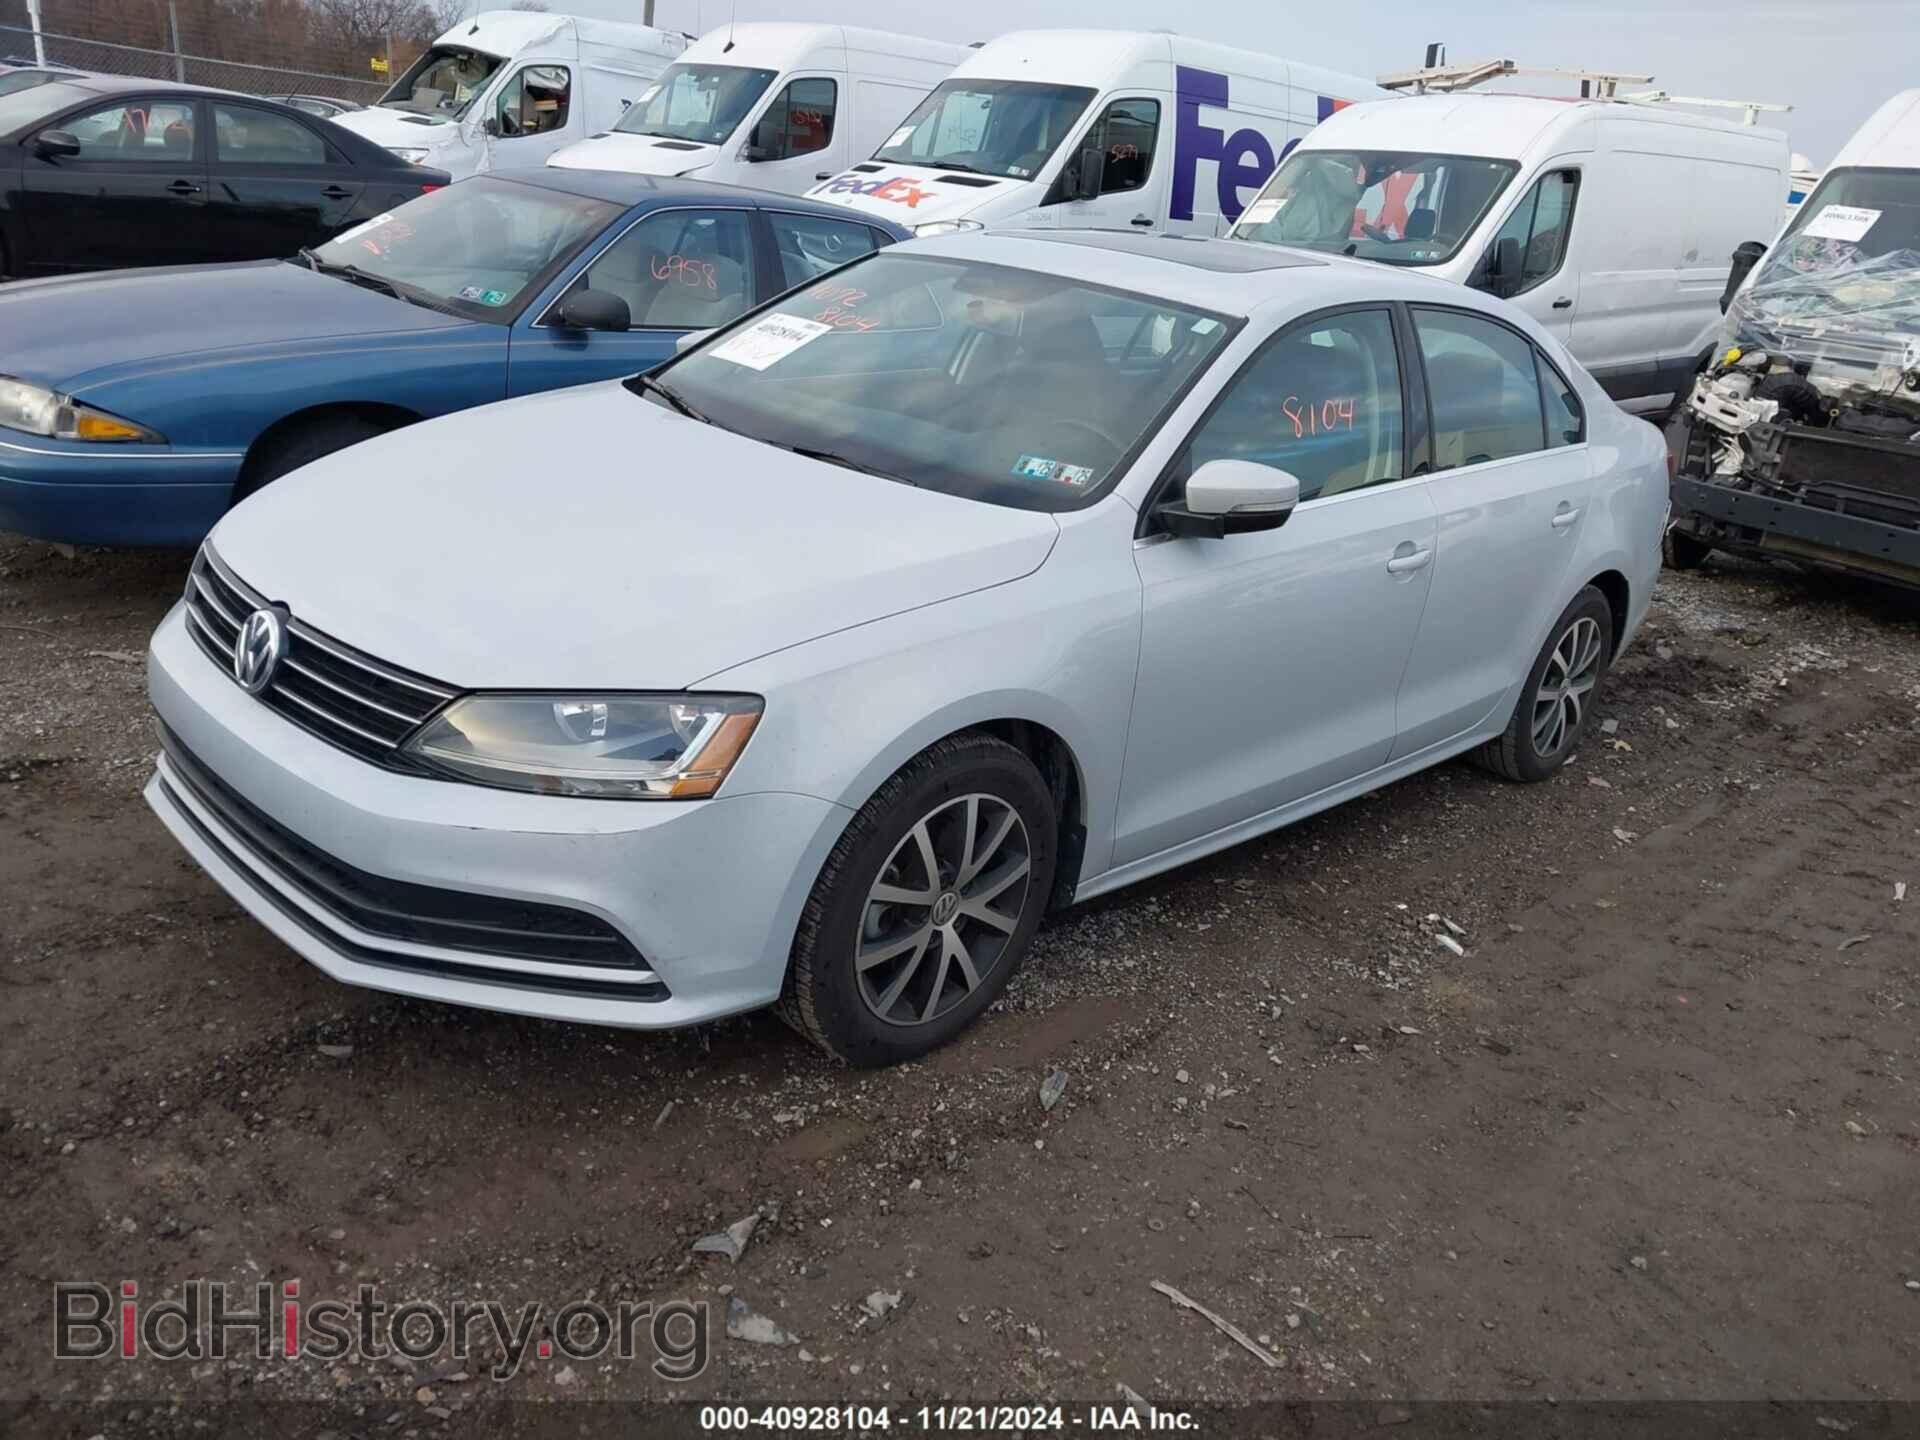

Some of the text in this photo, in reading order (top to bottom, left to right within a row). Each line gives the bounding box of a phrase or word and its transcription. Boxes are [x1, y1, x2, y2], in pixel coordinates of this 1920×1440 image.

[813, 174, 939, 209] FedEx
[650, 255, 718, 290] 6958
[1282, 396, 1354, 438] 8104
